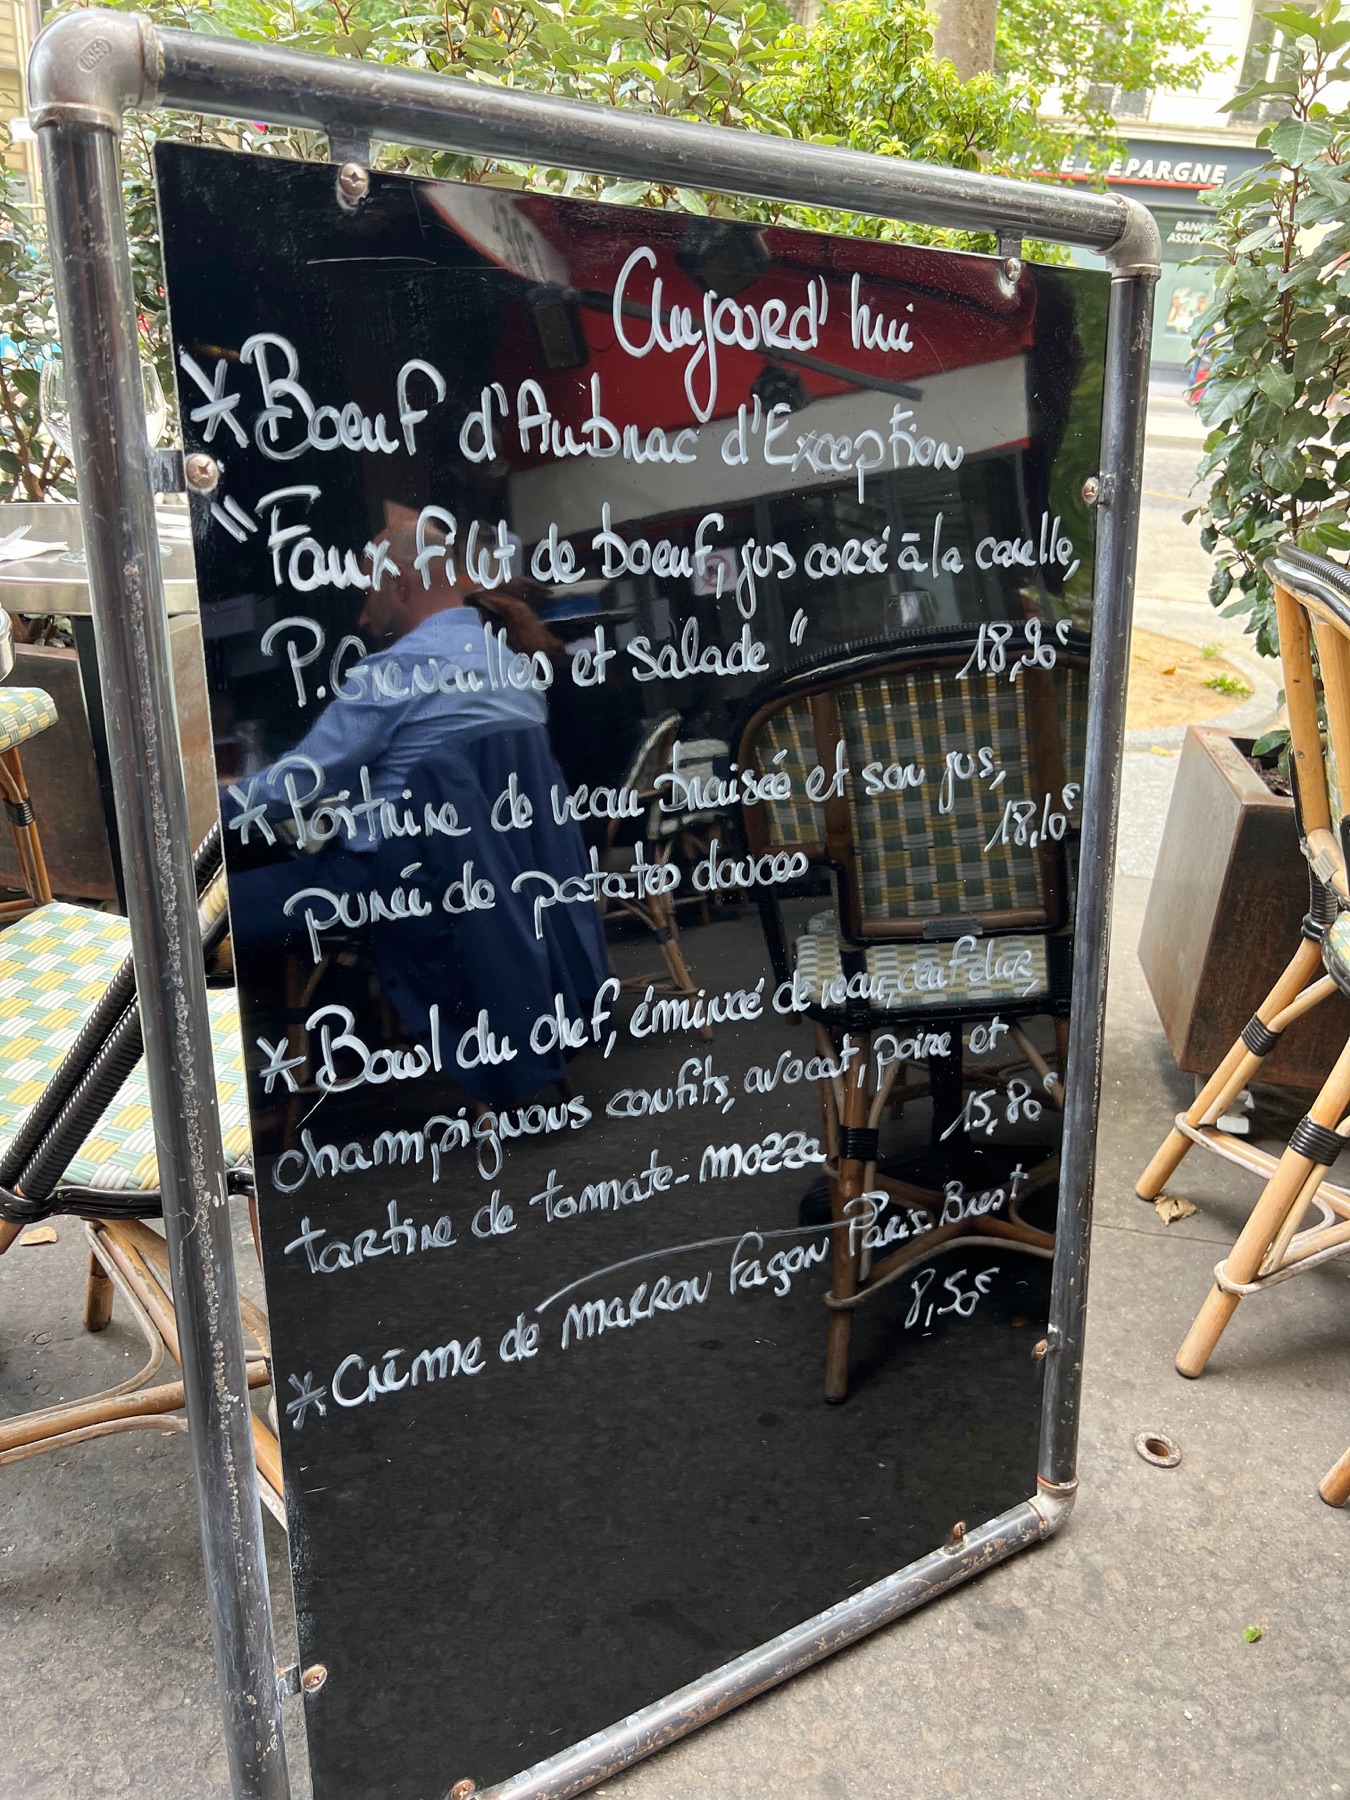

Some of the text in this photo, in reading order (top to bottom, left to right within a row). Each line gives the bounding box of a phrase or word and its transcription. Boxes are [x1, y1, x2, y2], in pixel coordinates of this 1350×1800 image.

[459, 372, 698, 464] d'Aubrac
[531, 523, 585, 583] de
[736, 538, 797, 619] jus
[932, 511, 964, 579] la
[572, 625, 617, 688] et
[491, 772, 533, 833] de
[551, 783, 645, 826] veau
[806, 739, 850, 803] et
[862, 761, 925, 796] son
[938, 745, 1007, 814] jus,
[442, 860, 496, 914] de
[511, 840, 681, 940] patates
[692, 838, 809, 892] douces
[305, 1004, 443, 1092] Bowl
[456, 1008, 518, 1070] du
[529, 977, 621, 1059] chef,
[771, 969, 812, 1015] de
[820, 971, 896, 1009] veau,
[272, 1016, 1010, 1194] champignons confits, avocat, poire et
[283, 1200, 457, 1274] tartine
[471, 1189, 518, 1238] de
[499, 1312, 540, 1362] de
